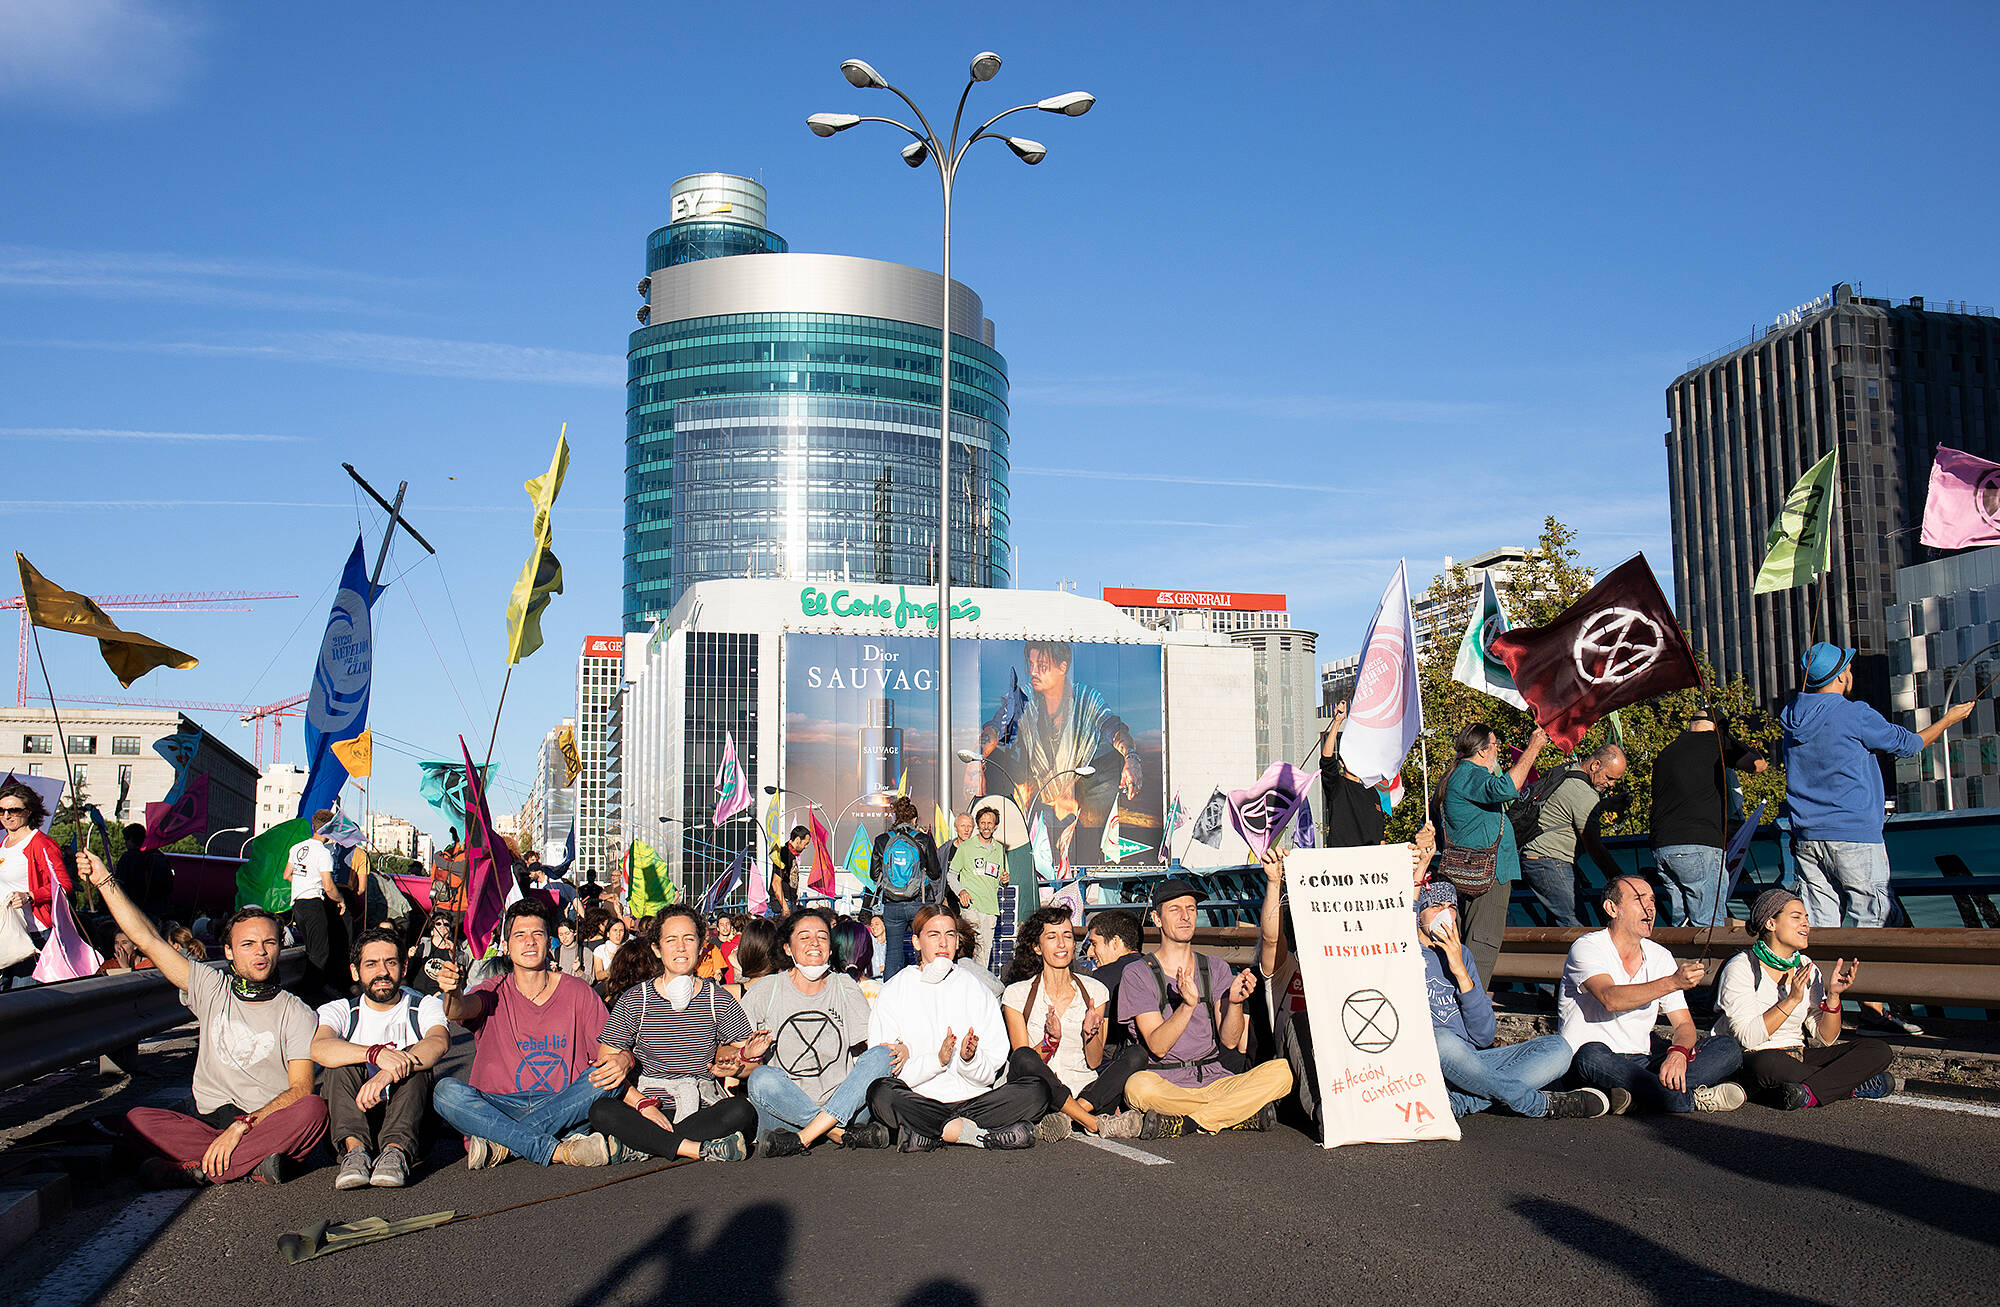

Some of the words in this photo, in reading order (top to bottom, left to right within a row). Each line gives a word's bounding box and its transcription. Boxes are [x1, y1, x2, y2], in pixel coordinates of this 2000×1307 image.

[672, 192, 704, 223] EY
[801, 587, 828, 616] El
[831, 590, 892, 618] Corte
[895, 586, 981, 629] Ingés
[1174, 592, 1231, 606] GENERALI
[863, 645, 899, 662] Dior
[864, 746, 898, 754] SAUVAGE
[874, 783, 890, 791] Dior
[1300, 870, 1353, 887] ¿CÓMO
[1360, 873, 1389, 885] NOS
[1311, 891, 1404, 912] RECORDARÁ
[1343, 920, 1363, 932] LA
[1324, 942, 1407, 957] HISTORIA?
[1395, 1101, 1435, 1123] YA
